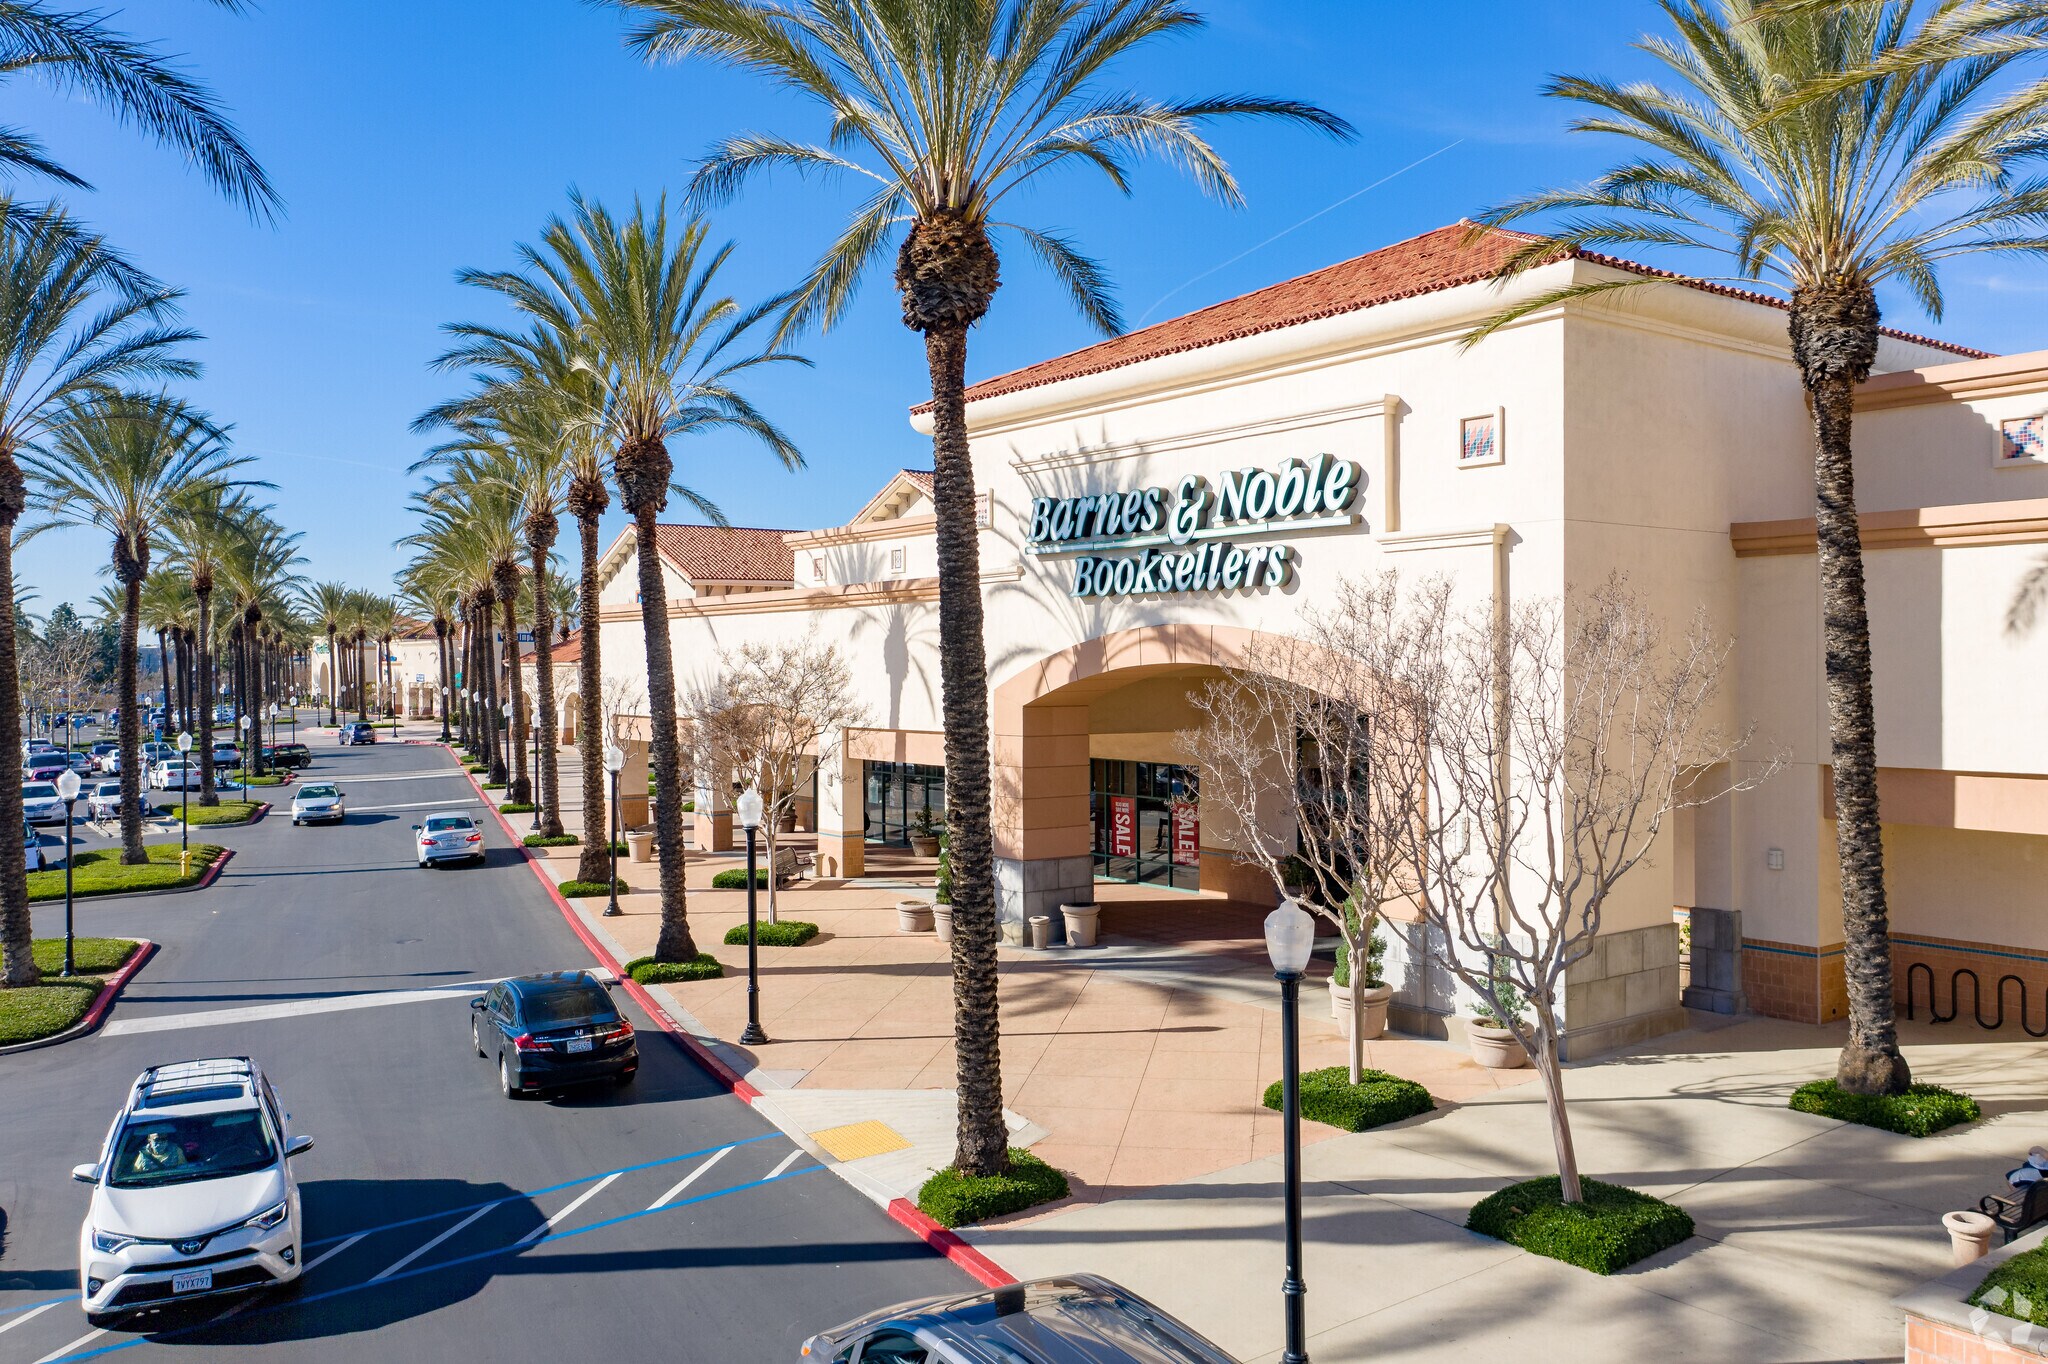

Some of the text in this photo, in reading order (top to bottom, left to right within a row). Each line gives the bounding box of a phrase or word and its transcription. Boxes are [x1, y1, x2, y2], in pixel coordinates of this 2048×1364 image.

[1025, 453, 1353, 546] Barnes & Noble
[1070, 542, 1287, 598] Booksellers
[1115, 813, 1131, 856] SALE
[1178, 807, 1196, 851] SALE
